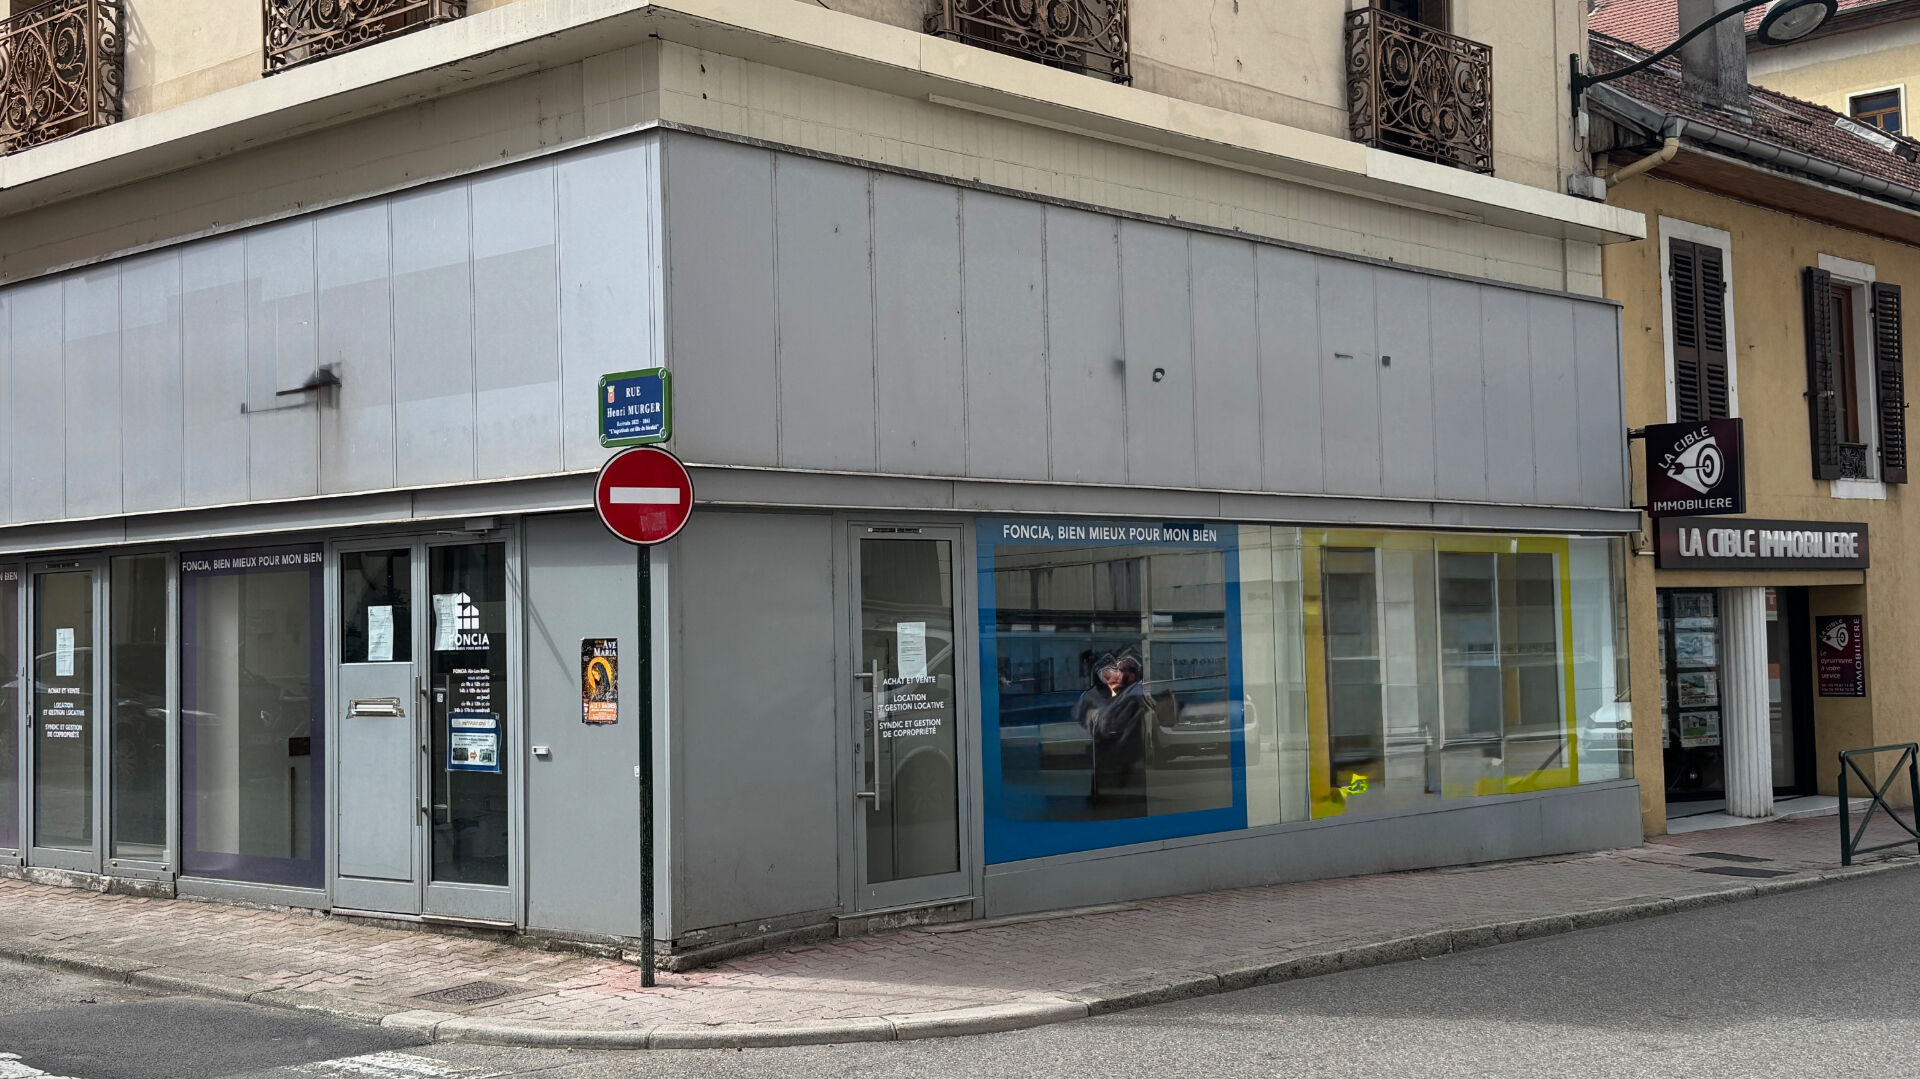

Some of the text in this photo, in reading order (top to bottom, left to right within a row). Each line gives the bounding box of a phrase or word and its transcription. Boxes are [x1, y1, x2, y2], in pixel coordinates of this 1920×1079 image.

[626, 386, 641, 398] RUE
[607, 402, 661, 418] Henri MURGER
[1658, 425, 1710, 469] LA CIBLE
[1653, 497, 1733, 512] IMMOBILIERE
[1003, 524, 1217, 542] FONCIA, BIEN MIEUX POUR MON BIEN
[1679, 528, 1859, 558] LA CIBLE IMMOBILIERE
[182, 552, 322, 571] FONCIA, BIEN MIEUX POUR MON BIEN
[4, 571, 18, 581] BIEN
[1825, 618, 1843, 631] CIBLE
[593, 647, 617, 656] MARIA
[1853, 618, 1863, 695] IMMOBILIERE
[882, 677, 905, 686] ACHAT
[915, 675, 937, 683] VENTE
[66, 687, 81, 695] VENTE
[893, 693, 927, 703] LOCATION
[884, 702, 913, 712] GESTION
[914, 701, 945, 710] LOCATIVE
[879, 718, 941, 730] SYNDIC ET GESTION
[882, 730, 892, 738] DE
